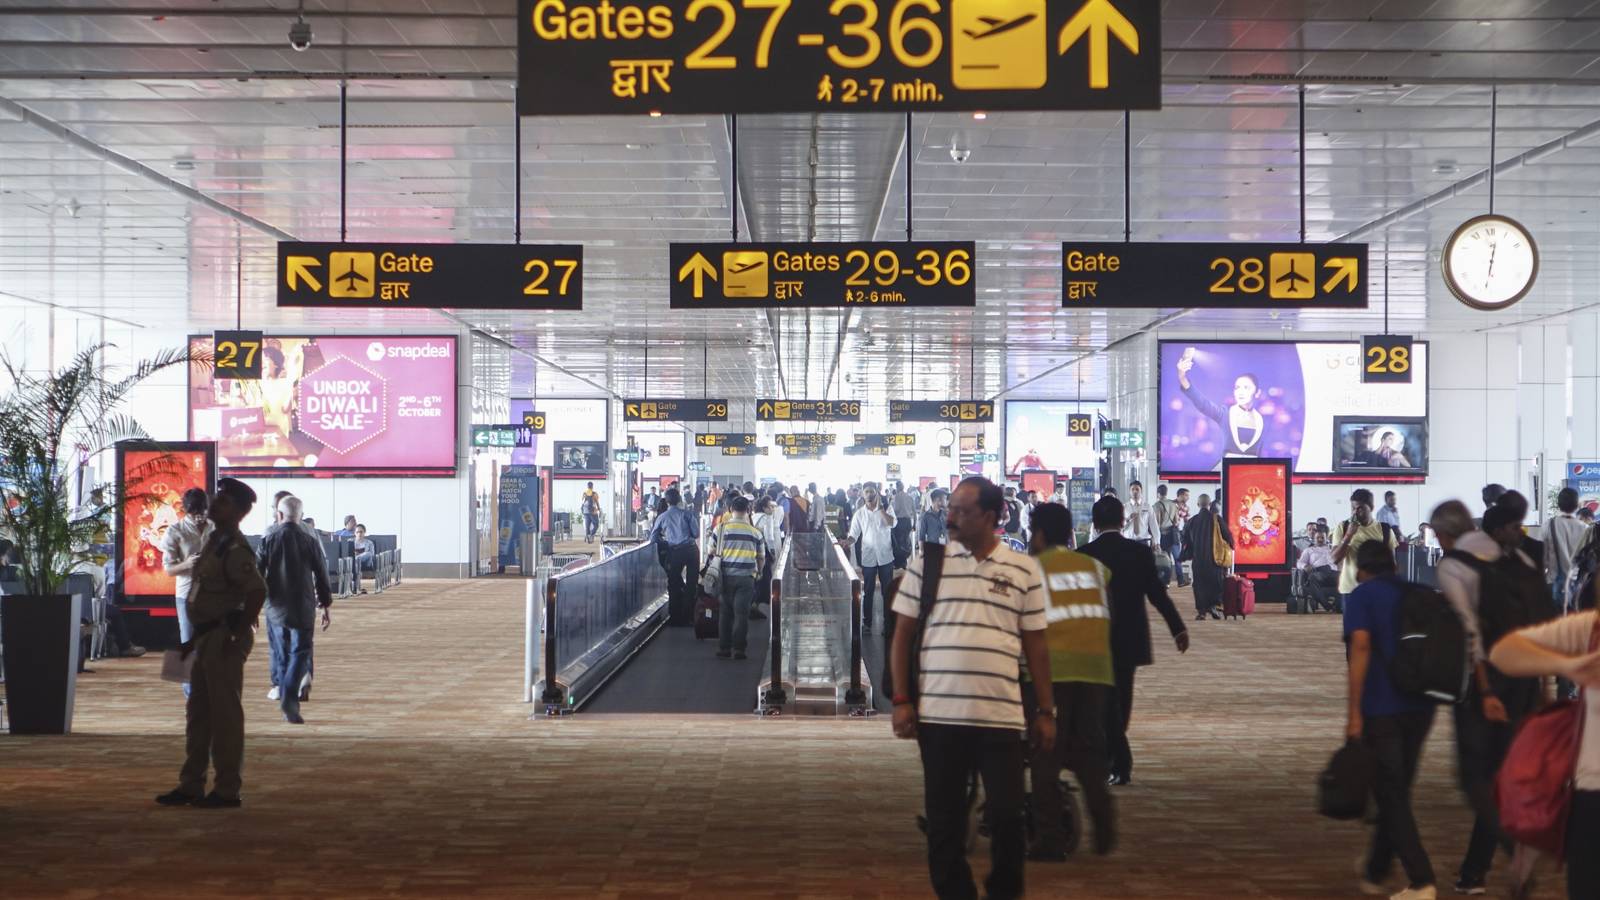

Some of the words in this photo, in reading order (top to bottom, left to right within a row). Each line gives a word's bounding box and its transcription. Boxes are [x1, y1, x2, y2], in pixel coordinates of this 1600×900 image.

[531, 0, 675, 41] Gates
[683, 0, 944, 69] 27-36
[609, 58, 674, 98] द्वार
[840, 78, 884, 103] 2-7
[891, 78, 944, 103] min.
[378, 252, 434, 273] Gate
[523, 258, 579, 295] 27
[772, 250, 841, 272] Gates
[845, 249, 970, 287] 29-36
[1066, 251, 1120, 272] Gate
[1208, 257, 1265, 293] 28
[380, 281, 411, 301] द्वार
[774, 280, 804, 300] द्वार
[856, 291, 880, 303] 2-6
[881, 291, 906, 303] min.
[1067, 281, 1098, 300] द्वार
[216, 341, 260, 369] 27
[387, 342, 450, 361] snapdeal
[1367, 346, 1409, 373] 28
[313, 380, 371, 395] UNBOX
[306, 396, 378, 413] DIWALI
[398, 408, 442, 417] OCTOBER
[657, 402, 677, 411] Gate
[706, 404, 727, 417] 29
[792, 402, 815, 410] Gates
[816, 402, 860, 416] 31-36
[939, 404, 960, 418] 30
[320, 413, 365, 430] SALE
[1069, 418, 1090, 432] 30
